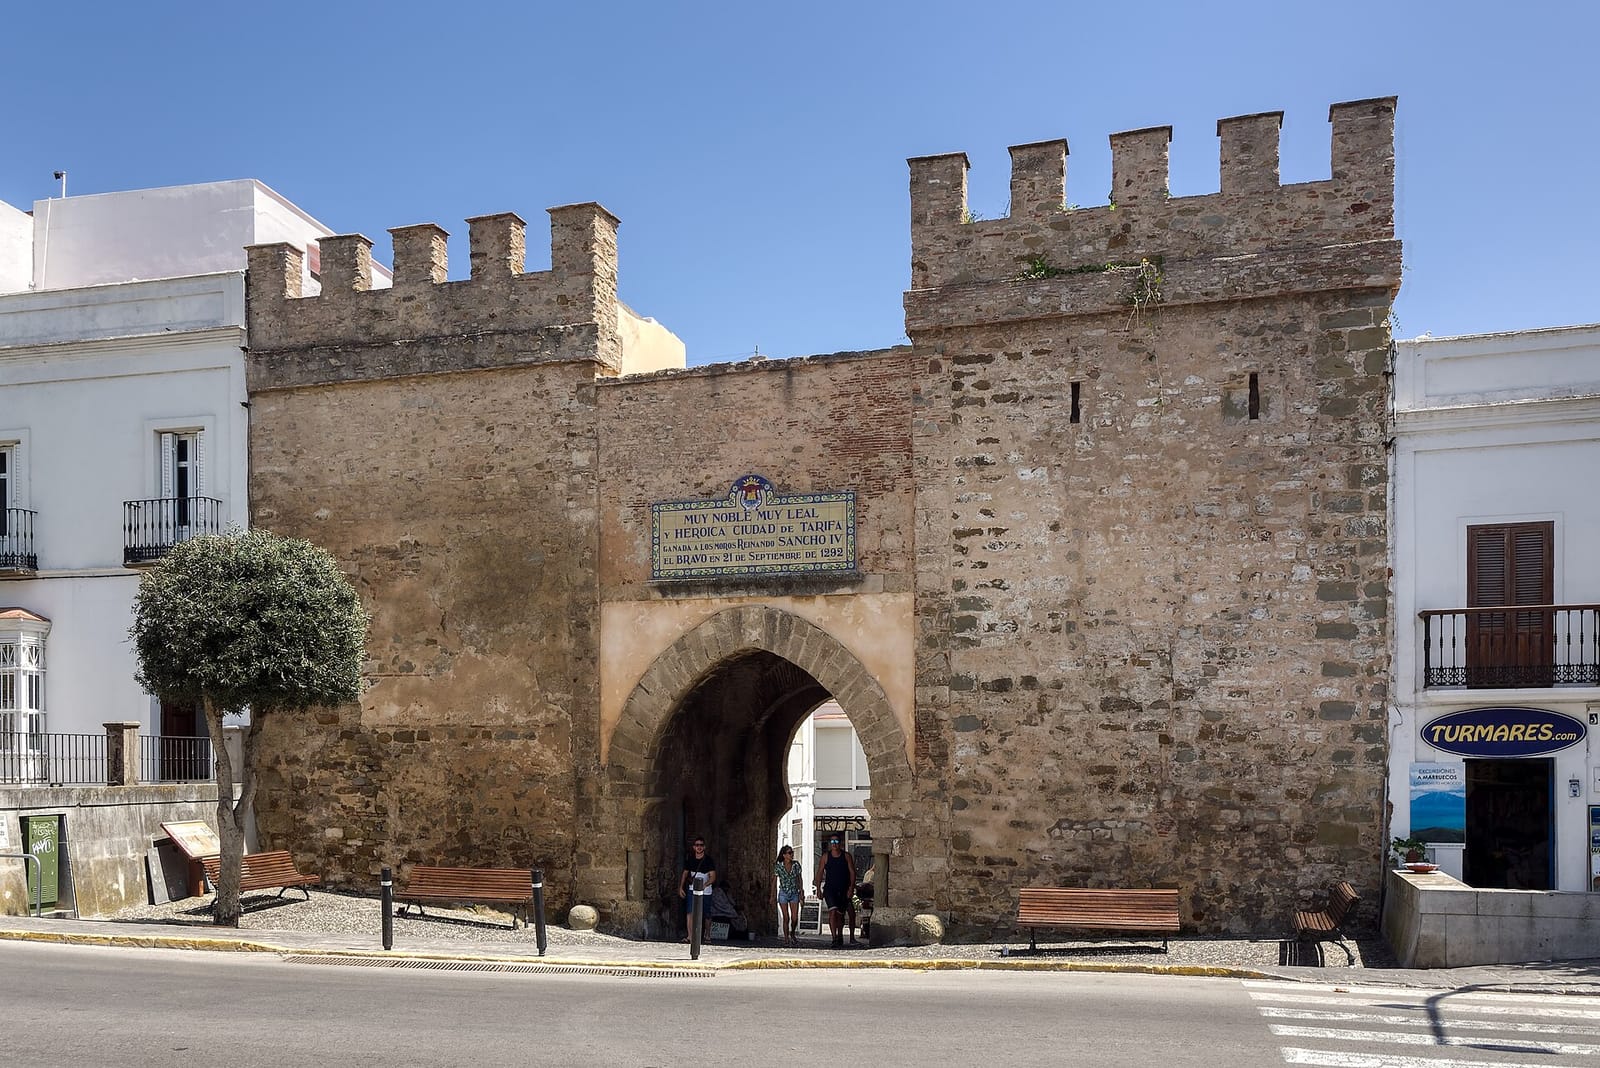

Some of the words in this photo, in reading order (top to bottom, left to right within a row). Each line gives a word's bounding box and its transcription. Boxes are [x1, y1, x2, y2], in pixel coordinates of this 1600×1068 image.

[684, 514, 712, 525] MUY
[713, 511, 751, 522] NOBLE
[757, 510, 783, 521] MUY
[787, 508, 819, 519] LEAL
[675, 526, 726, 539] HEROICA
[733, 524, 775, 535] CIUDAD
[781, 525, 794, 533] DE
[800, 520, 842, 532] TARIFA
[663, 543, 692, 552] GANADA
[700, 542, 713, 550] LOS
[714, 541, 736, 550] MOROS
[737, 538, 774, 550] REINANDO
[778, 535, 825, 547] SANCHO
[830, 534, 843, 544] IV
[664, 557, 673, 565] EL
[677, 554, 707, 565] BRAVO
[723, 553, 732, 562] 21
[820, 548, 843, 558] 1292
